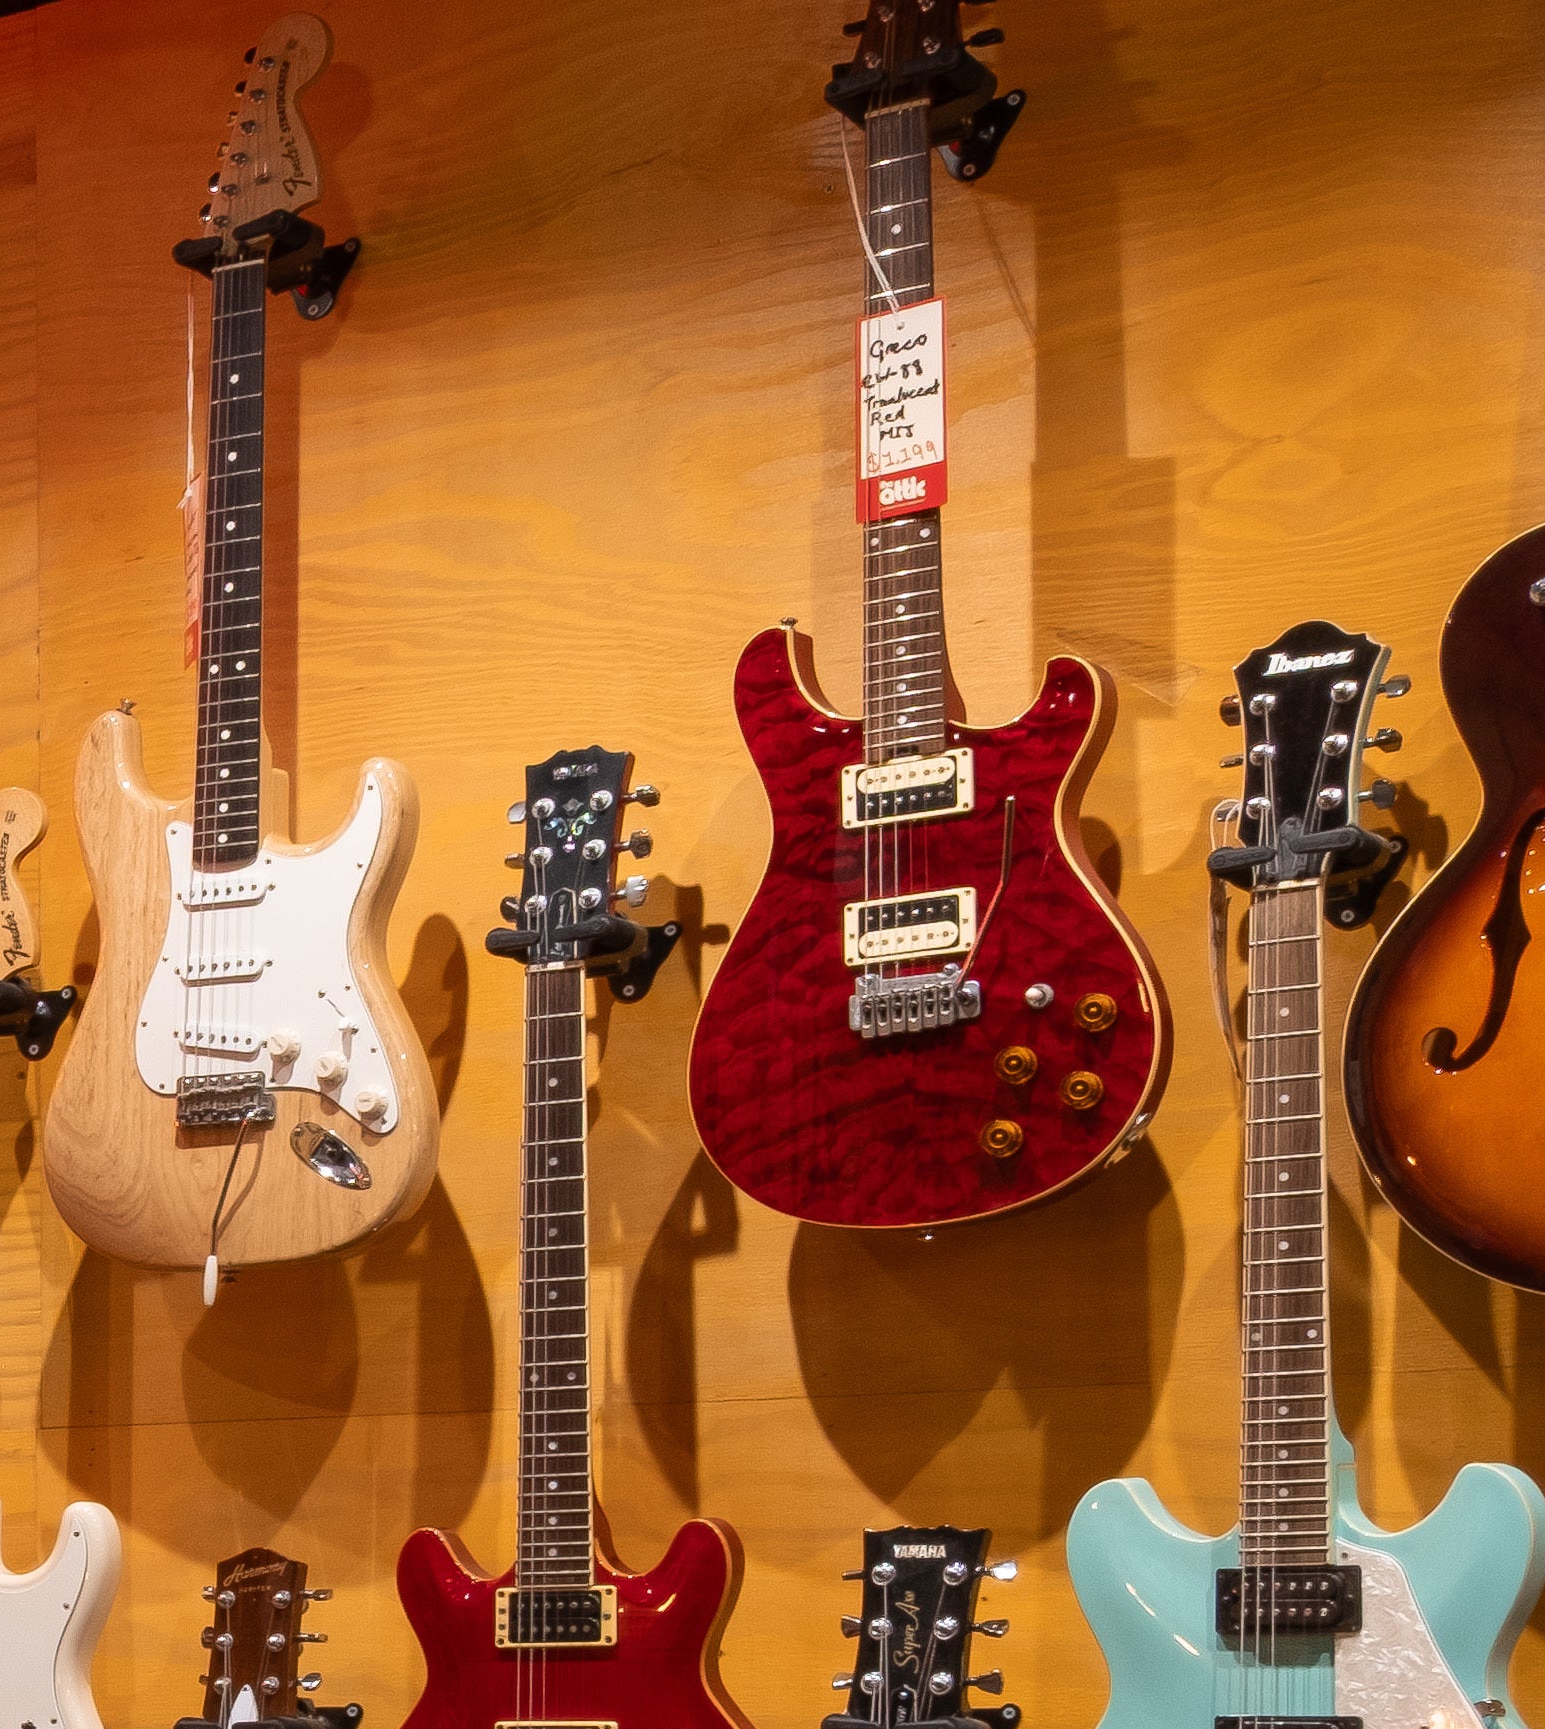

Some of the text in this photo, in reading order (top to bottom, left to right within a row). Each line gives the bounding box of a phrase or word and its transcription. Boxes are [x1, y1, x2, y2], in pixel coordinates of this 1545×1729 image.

[280, 136, 313, 197] Fender
[868, 334, 928, 363] Greco
[870, 404, 906, 426] Red
[878, 423, 916, 441] MIJ
[878, 476, 927, 506] attic
[1262, 649, 1356, 677] Ibanez
[2, 910, 31, 967] Fender
[892, 1544, 947, 1559] YAMAHA
[222, 1561, 288, 1587] Harmony
[895, 1589, 920, 1631] Axe
[892, 1629, 920, 1675] Super
